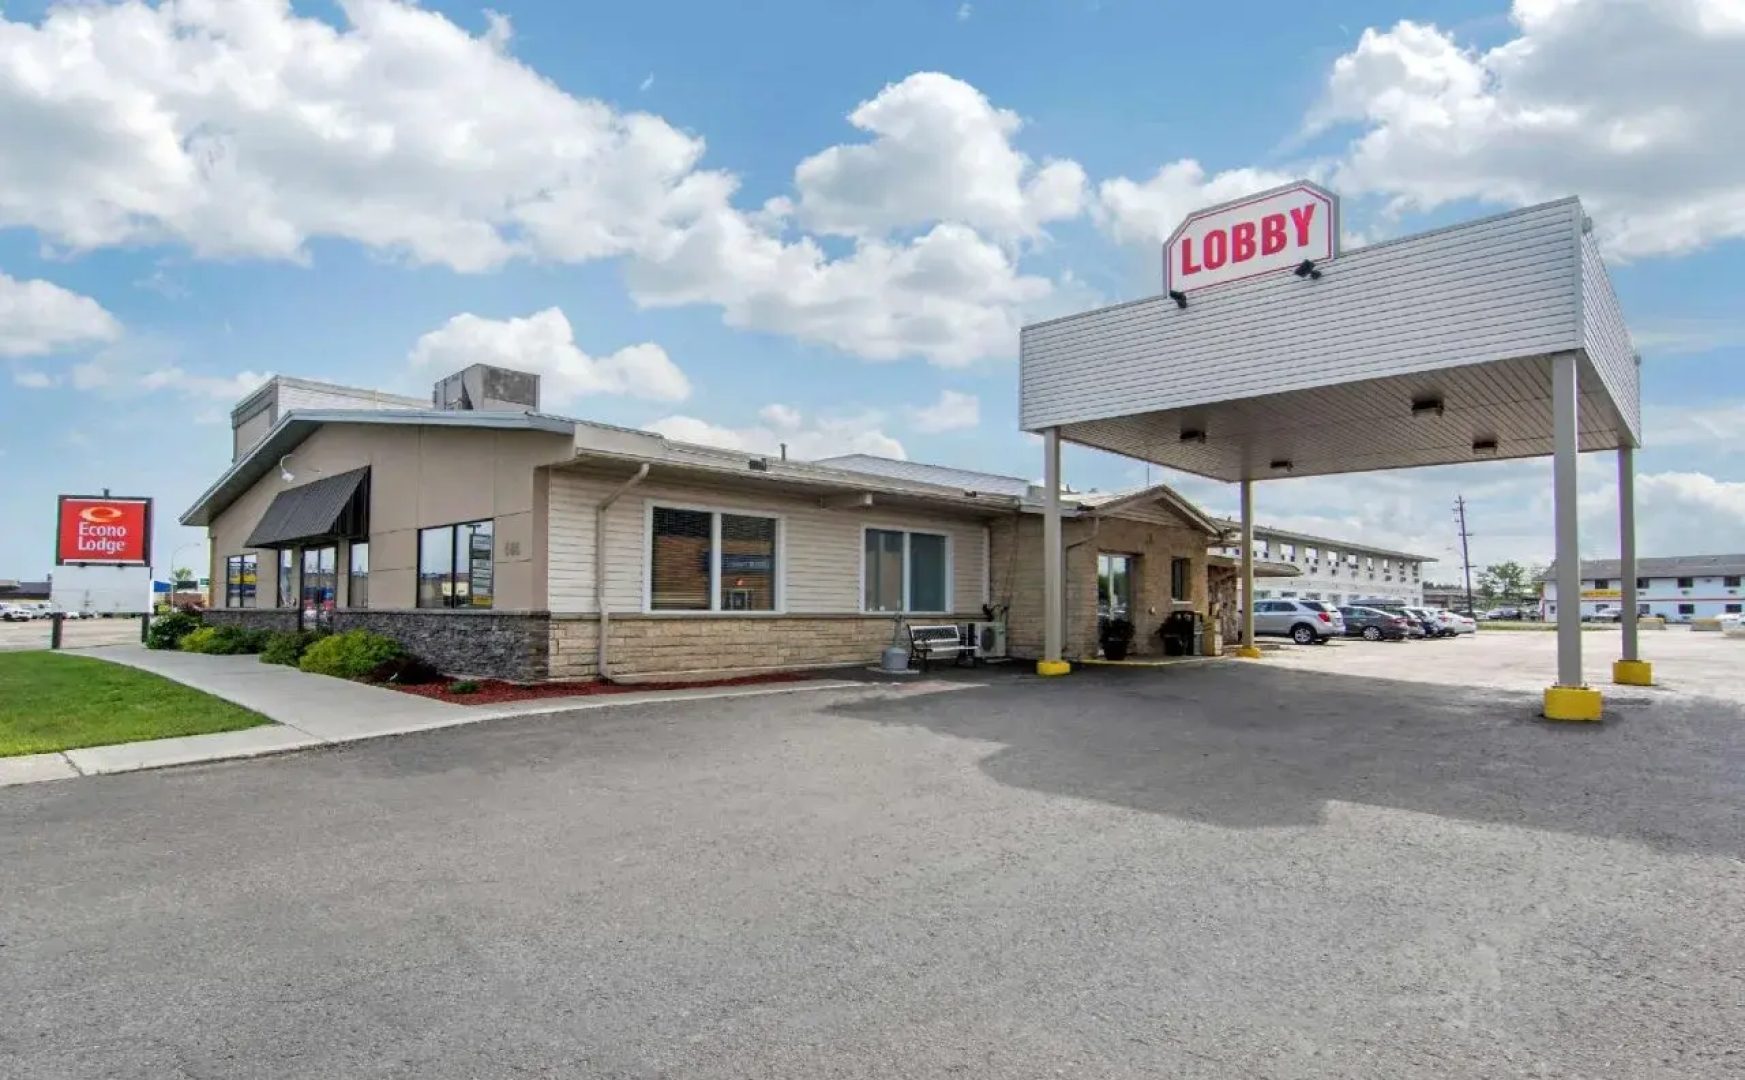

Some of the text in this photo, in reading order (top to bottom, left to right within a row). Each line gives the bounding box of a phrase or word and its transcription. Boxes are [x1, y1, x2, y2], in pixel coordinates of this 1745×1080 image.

[1182, 204, 1315, 275] LOBBY
[78, 522, 126, 537] Econo
[78, 536, 125, 554] Lodge
